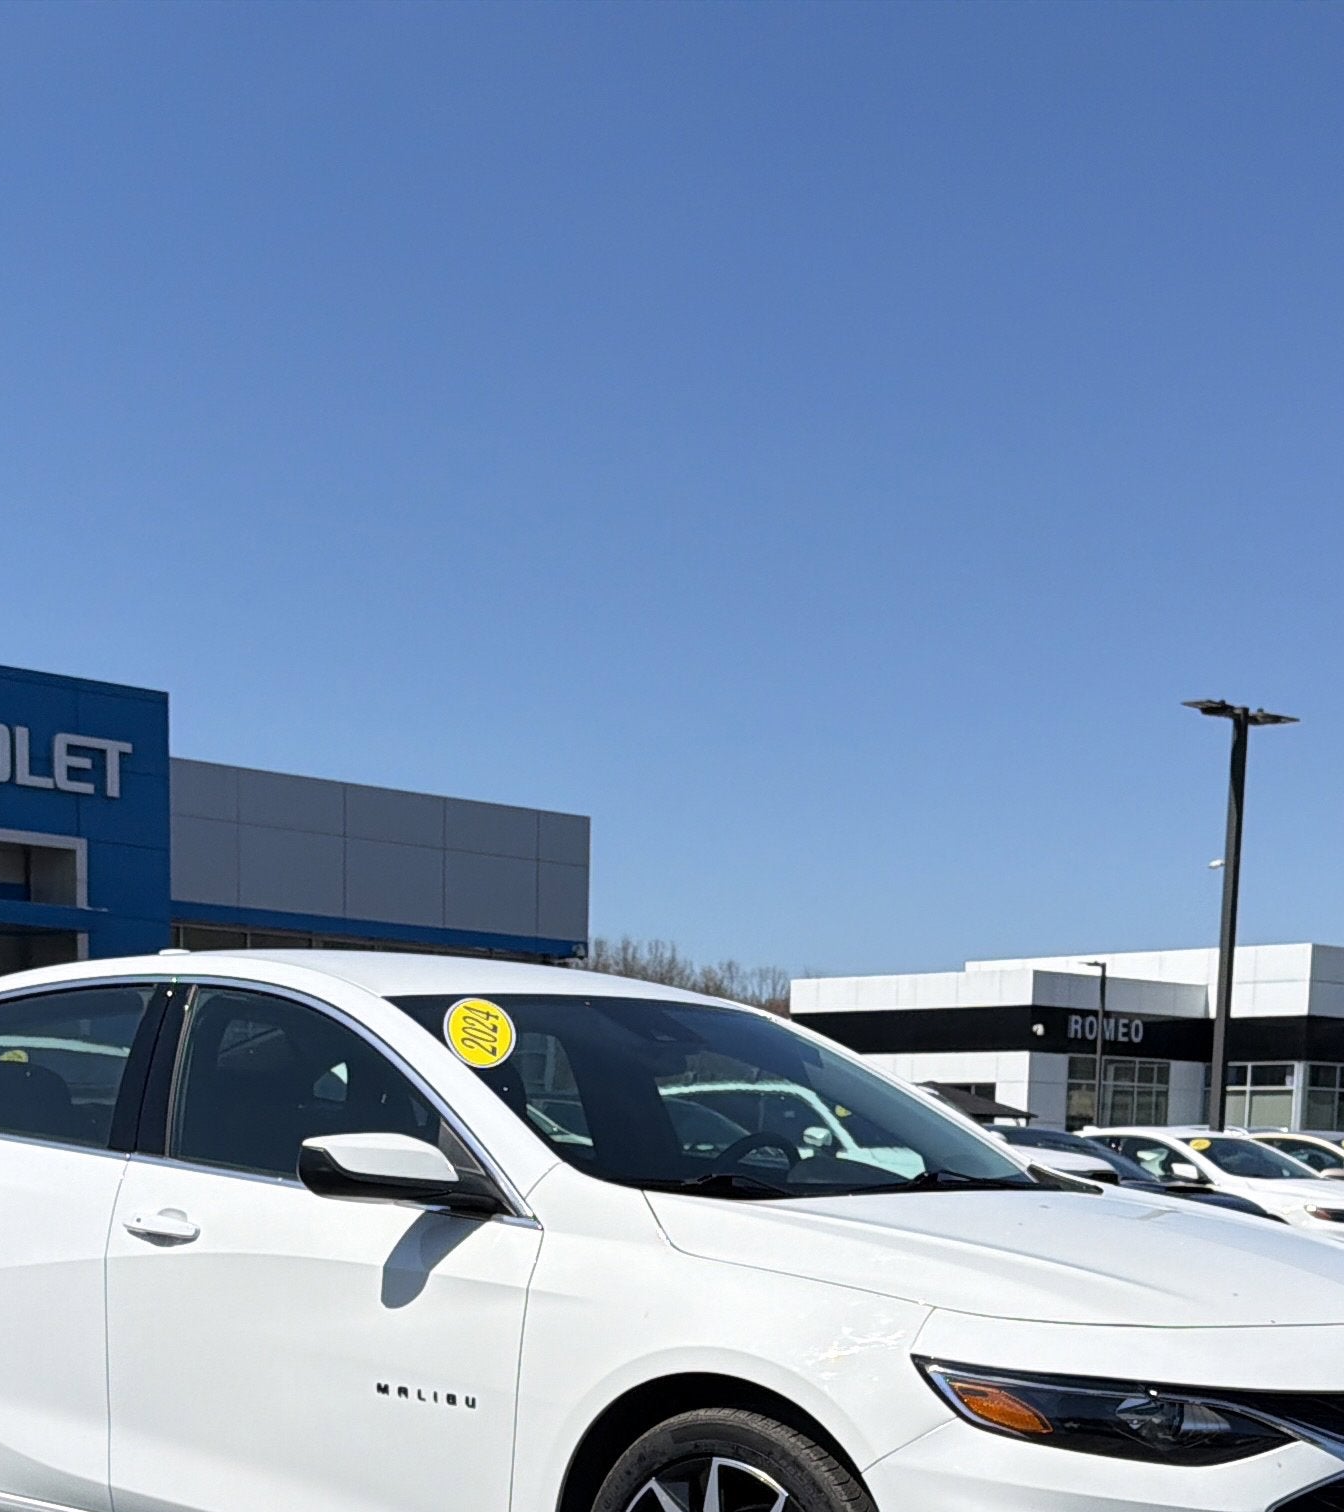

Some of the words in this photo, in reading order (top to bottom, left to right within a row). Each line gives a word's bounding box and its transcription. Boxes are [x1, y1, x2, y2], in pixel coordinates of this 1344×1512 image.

[461, 1005, 499, 1057] 2024
[1067, 1014, 1144, 1043] ROMEO
[376, 1382, 476, 1409] MALIBU
